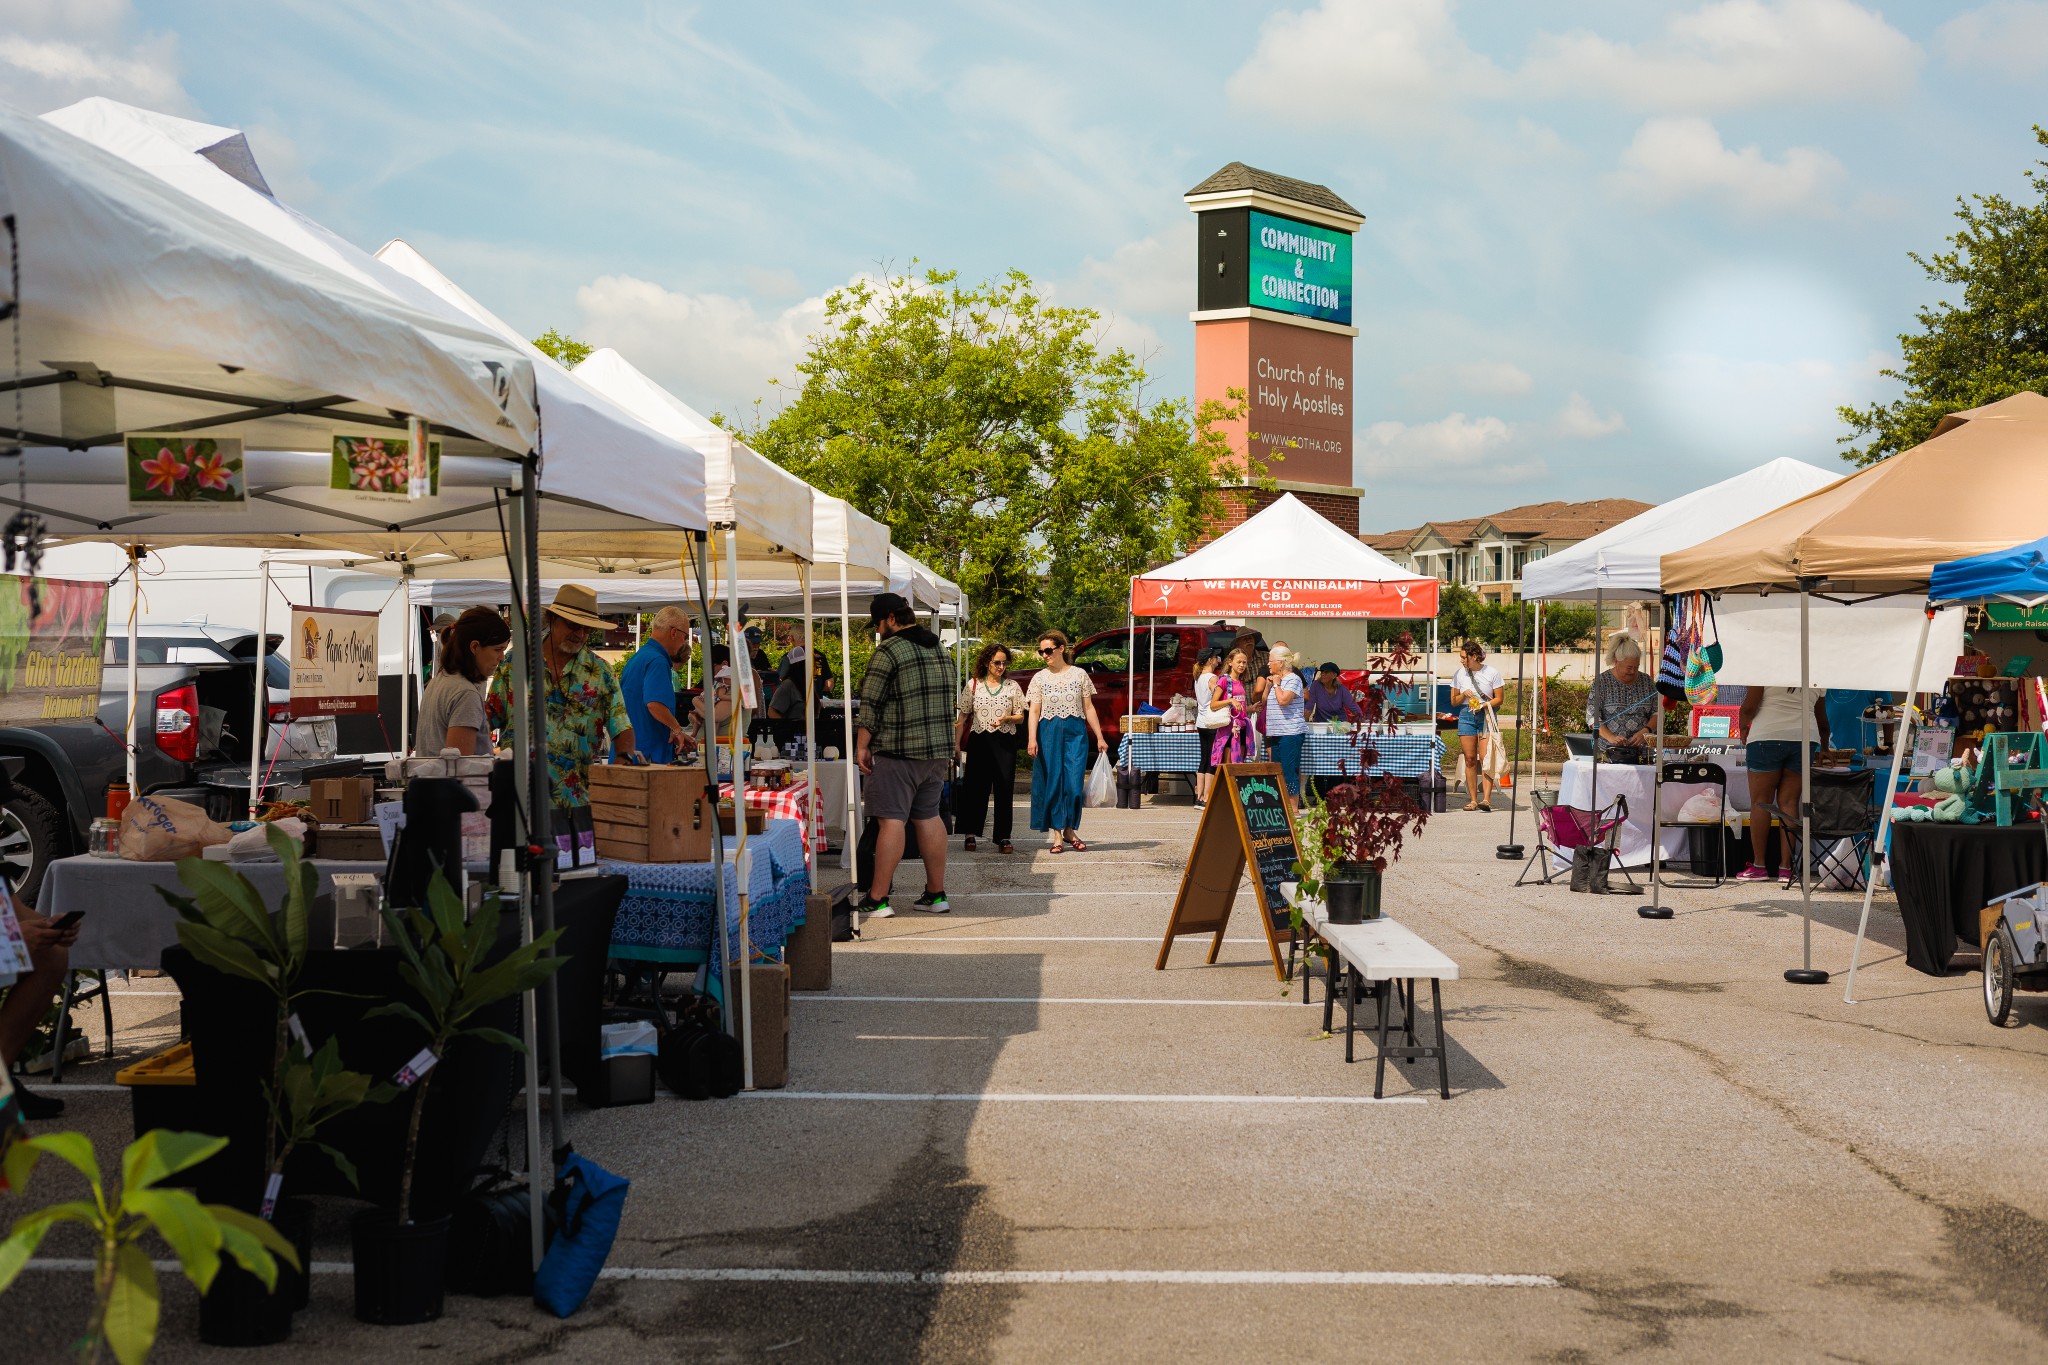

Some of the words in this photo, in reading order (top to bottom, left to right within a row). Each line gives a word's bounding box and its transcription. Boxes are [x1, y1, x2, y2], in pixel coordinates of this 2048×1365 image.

[1260, 226, 1337, 263] COMMUNITY
[1294, 258, 1304, 280] &
[1261, 274, 1339, 310] CONNECTION
[1257, 357, 1305, 384] Church
[1308, 366, 1322, 387] of
[1325, 368, 1345, 390] the
[1258, 384, 1288, 413] Holy
[1292, 390, 1344, 416] Apostles
[1260, 432, 1342, 454] WWWCOTHA.ORG
[1203, 580, 1226, 589] WE
[1230, 580, 1269, 590] HAVE
[1272, 580, 1363, 590] CANNIBALM!
[1261, 591, 1291, 601] CBD
[1991, 620, 2023, 628] Pasture
[2025, 620, 2048, 628] Raise
[1247, 807, 1287, 828] PICKLES
